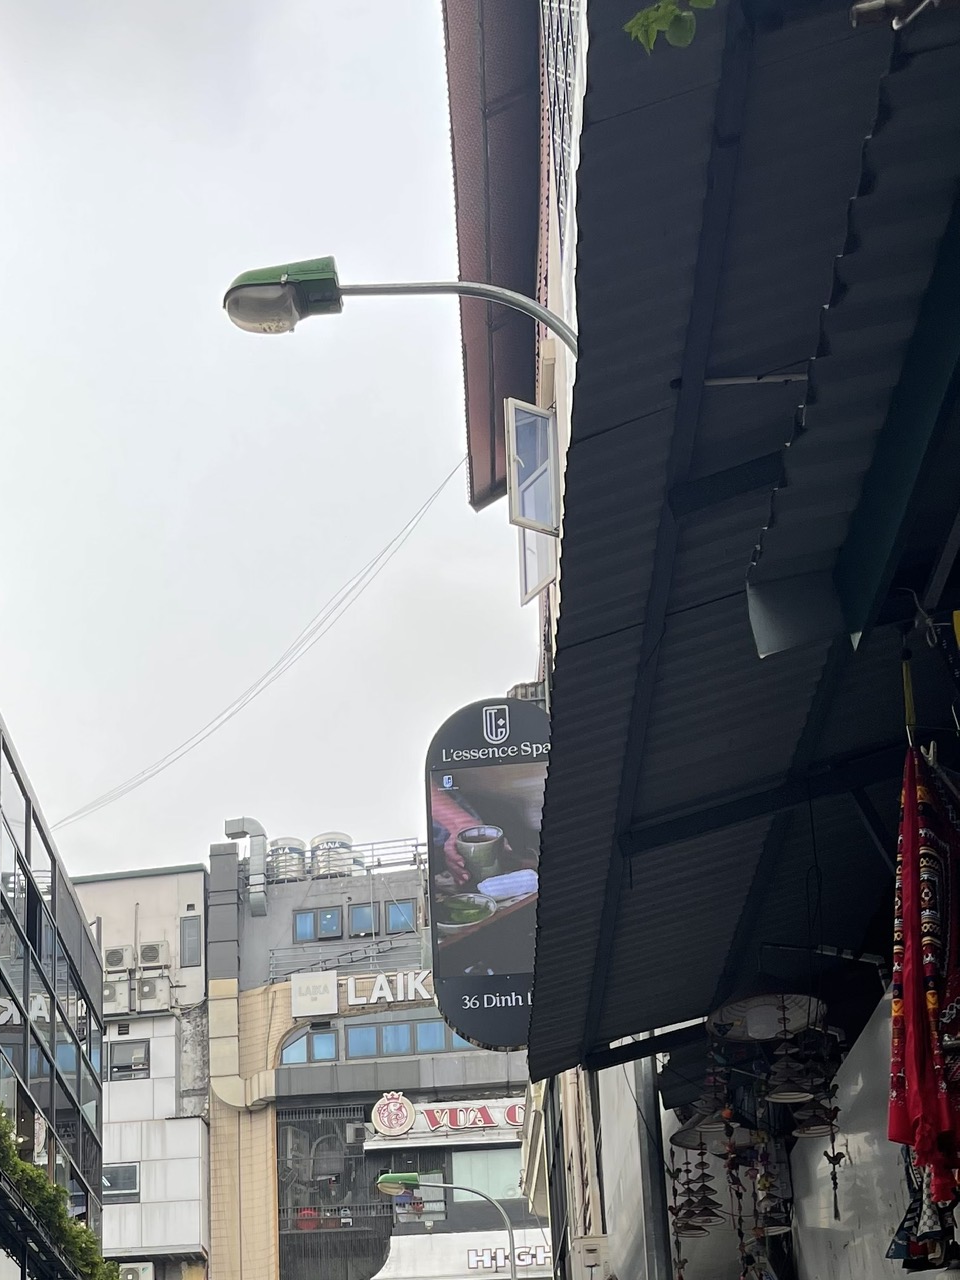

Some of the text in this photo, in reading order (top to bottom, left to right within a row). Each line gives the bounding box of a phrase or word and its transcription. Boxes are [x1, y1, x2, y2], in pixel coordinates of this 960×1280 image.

[442, 741, 551, 762] L'essence Spa
[347, 970, 433, 1006] LAIK
[461, 995, 480, 1010] 36
[483, 991, 524, 1008] Dinh
[421, 1104, 499, 1131] VUA
